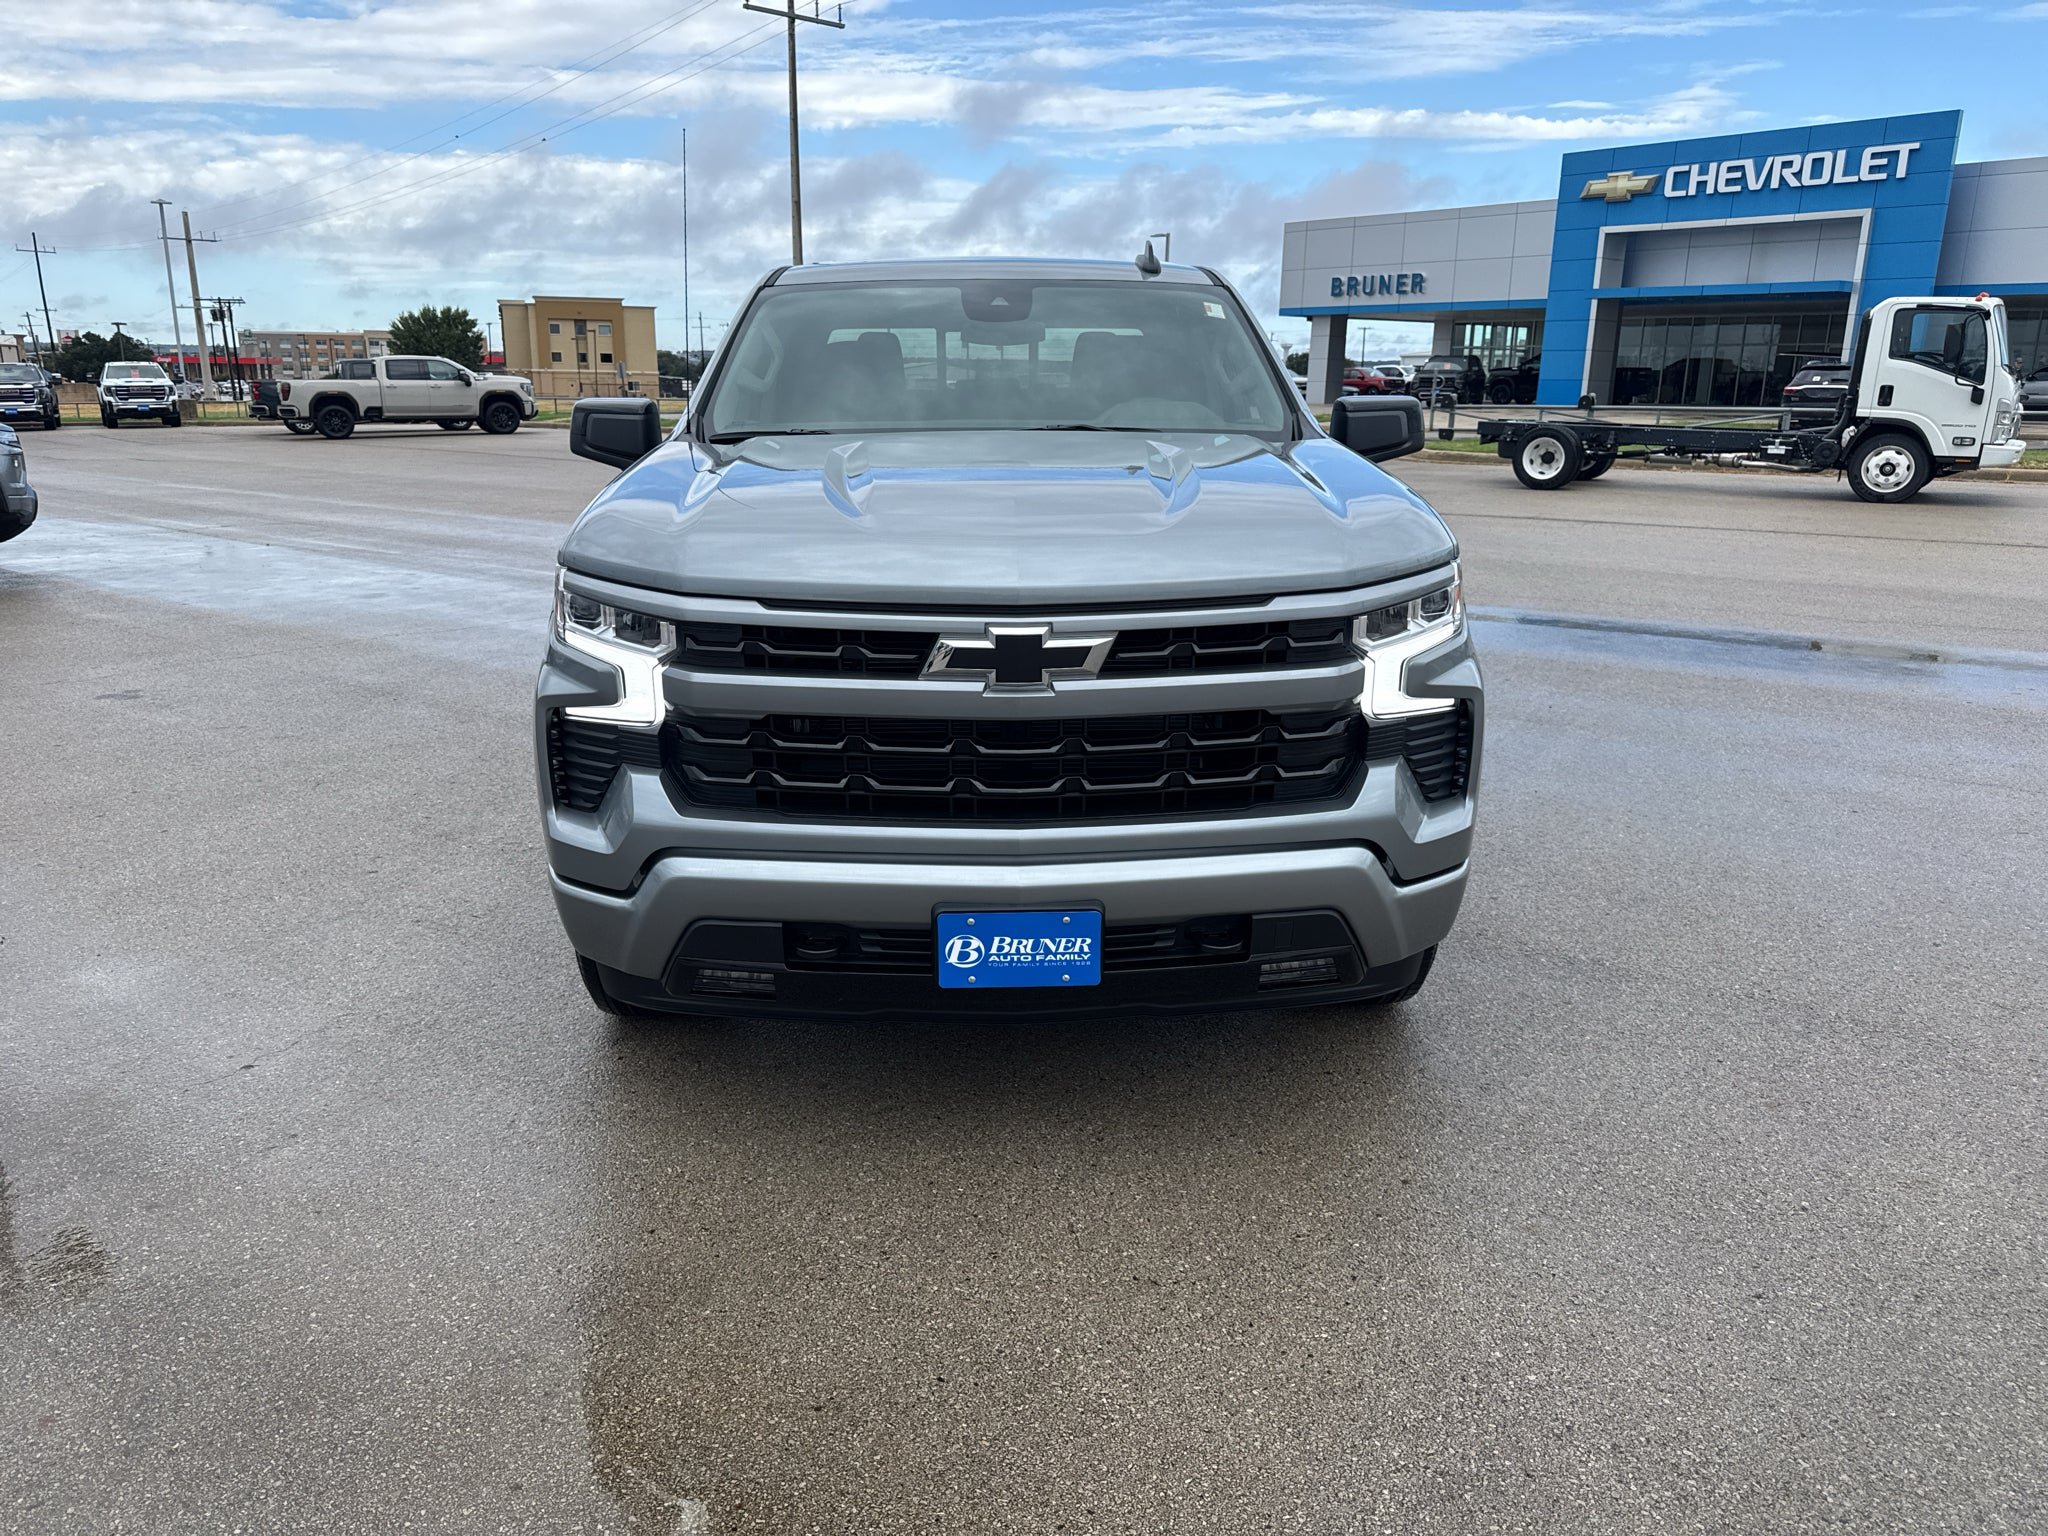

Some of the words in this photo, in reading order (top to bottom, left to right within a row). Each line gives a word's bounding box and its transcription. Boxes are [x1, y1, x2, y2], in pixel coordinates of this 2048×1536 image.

[1664, 142, 1921, 198] CHEVROLET
[1330, 272, 1426, 297] BRUNER
[945, 938, 981, 964] B
[988, 936, 1092, 954] BRUNER
